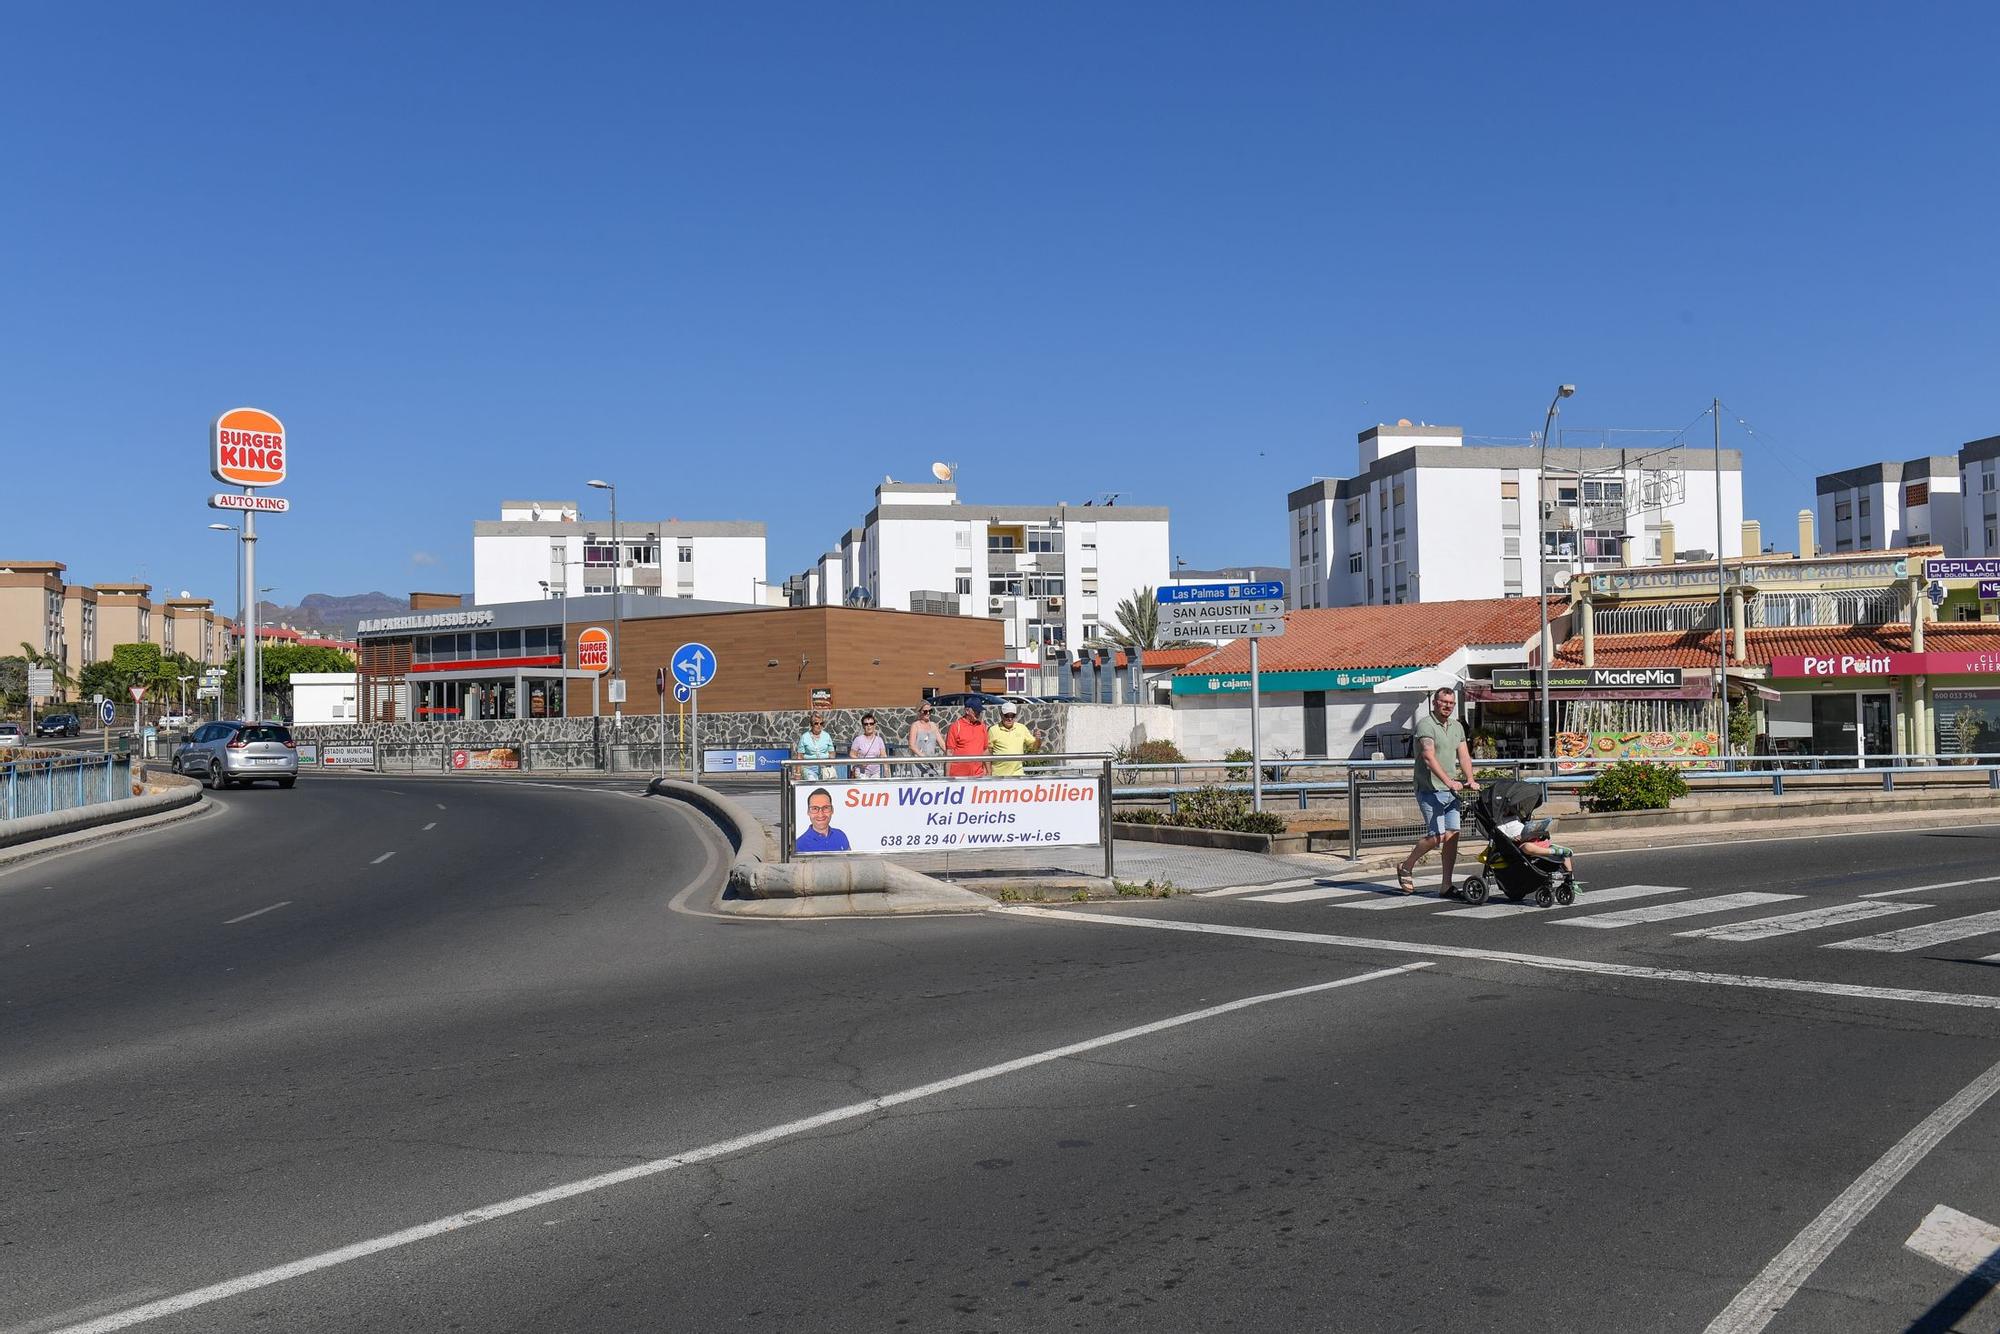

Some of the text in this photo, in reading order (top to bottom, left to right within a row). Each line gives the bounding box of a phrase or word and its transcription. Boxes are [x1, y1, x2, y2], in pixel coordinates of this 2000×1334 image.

[220, 431, 283, 450] BURGER
[220, 446, 283, 470] KING
[220, 495, 285, 510] AUTO KING
[1172, 586, 1265, 600] Las Palmas GC-1
[1173, 603, 1251, 618] SAN AGUSTÍN
[1174, 624, 1248, 637] BAHÍA FELIZ
[580, 643, 607, 652] BURGER
[580, 651, 607, 664] KING
[1804, 656, 1891, 675] Pet Point
[1222, 678, 1252, 690] cajam
[1595, 670, 1675, 685] MadreMia
[844, 783, 1094, 808] Sun World Immobilien
[926, 811, 1016, 826] Kai Derichs
[880, 835, 903, 847] 638
[906, 835, 921, 846] 28
[924, 834, 939, 845] 29
[942, 834, 957, 845] 40
[967, 830, 1061, 844] www.s-w-i.es
